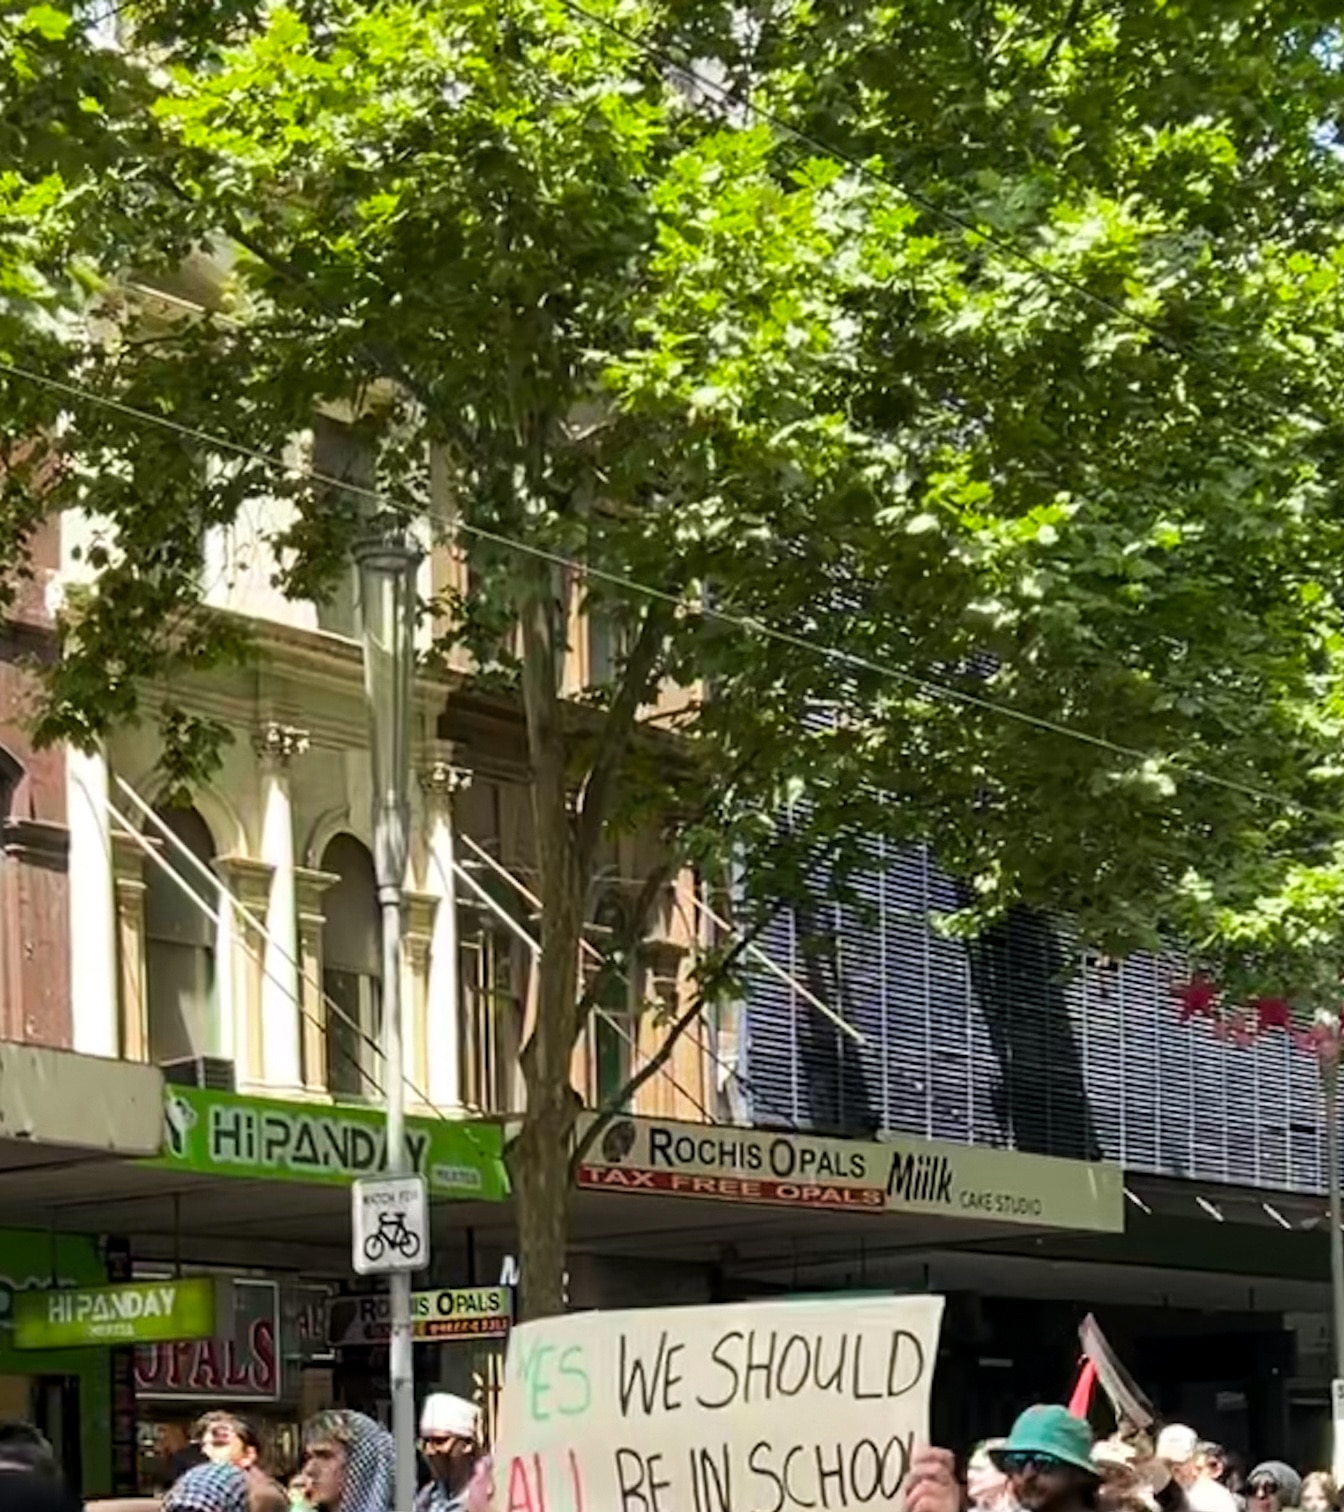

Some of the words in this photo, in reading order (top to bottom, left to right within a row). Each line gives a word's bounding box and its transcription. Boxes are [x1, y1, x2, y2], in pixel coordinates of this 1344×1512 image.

[649, 1128, 762, 1170] ROCHIS
[769, 1138, 866, 1180] OPALS
[584, 1168, 657, 1188] TAX
[671, 1176, 761, 1197] FREE
[776, 1186, 882, 1206] OPALS
[960, 1191, 992, 1211] CAKE
[996, 1195, 1042, 1216] STUDIO
[436, 1291, 499, 1317] OPALS
[618, 1331, 685, 1417] WE
[696, 1329, 925, 1409] SHOULD
